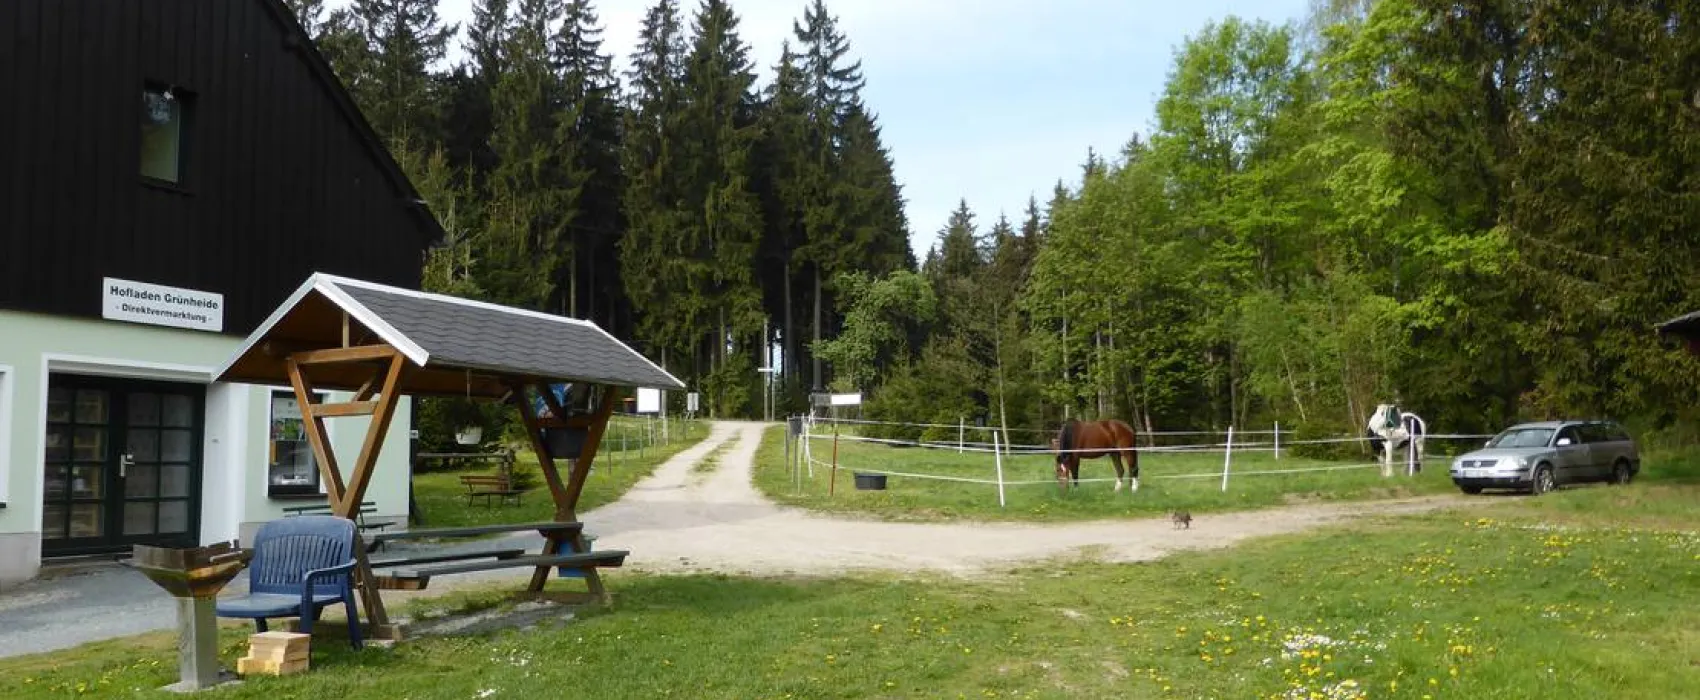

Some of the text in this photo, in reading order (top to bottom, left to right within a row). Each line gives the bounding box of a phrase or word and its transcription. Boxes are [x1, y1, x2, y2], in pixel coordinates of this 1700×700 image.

[109, 285, 219, 309] Hofladen Grünheide
[122, 303, 207, 323] Direktvermarktung
